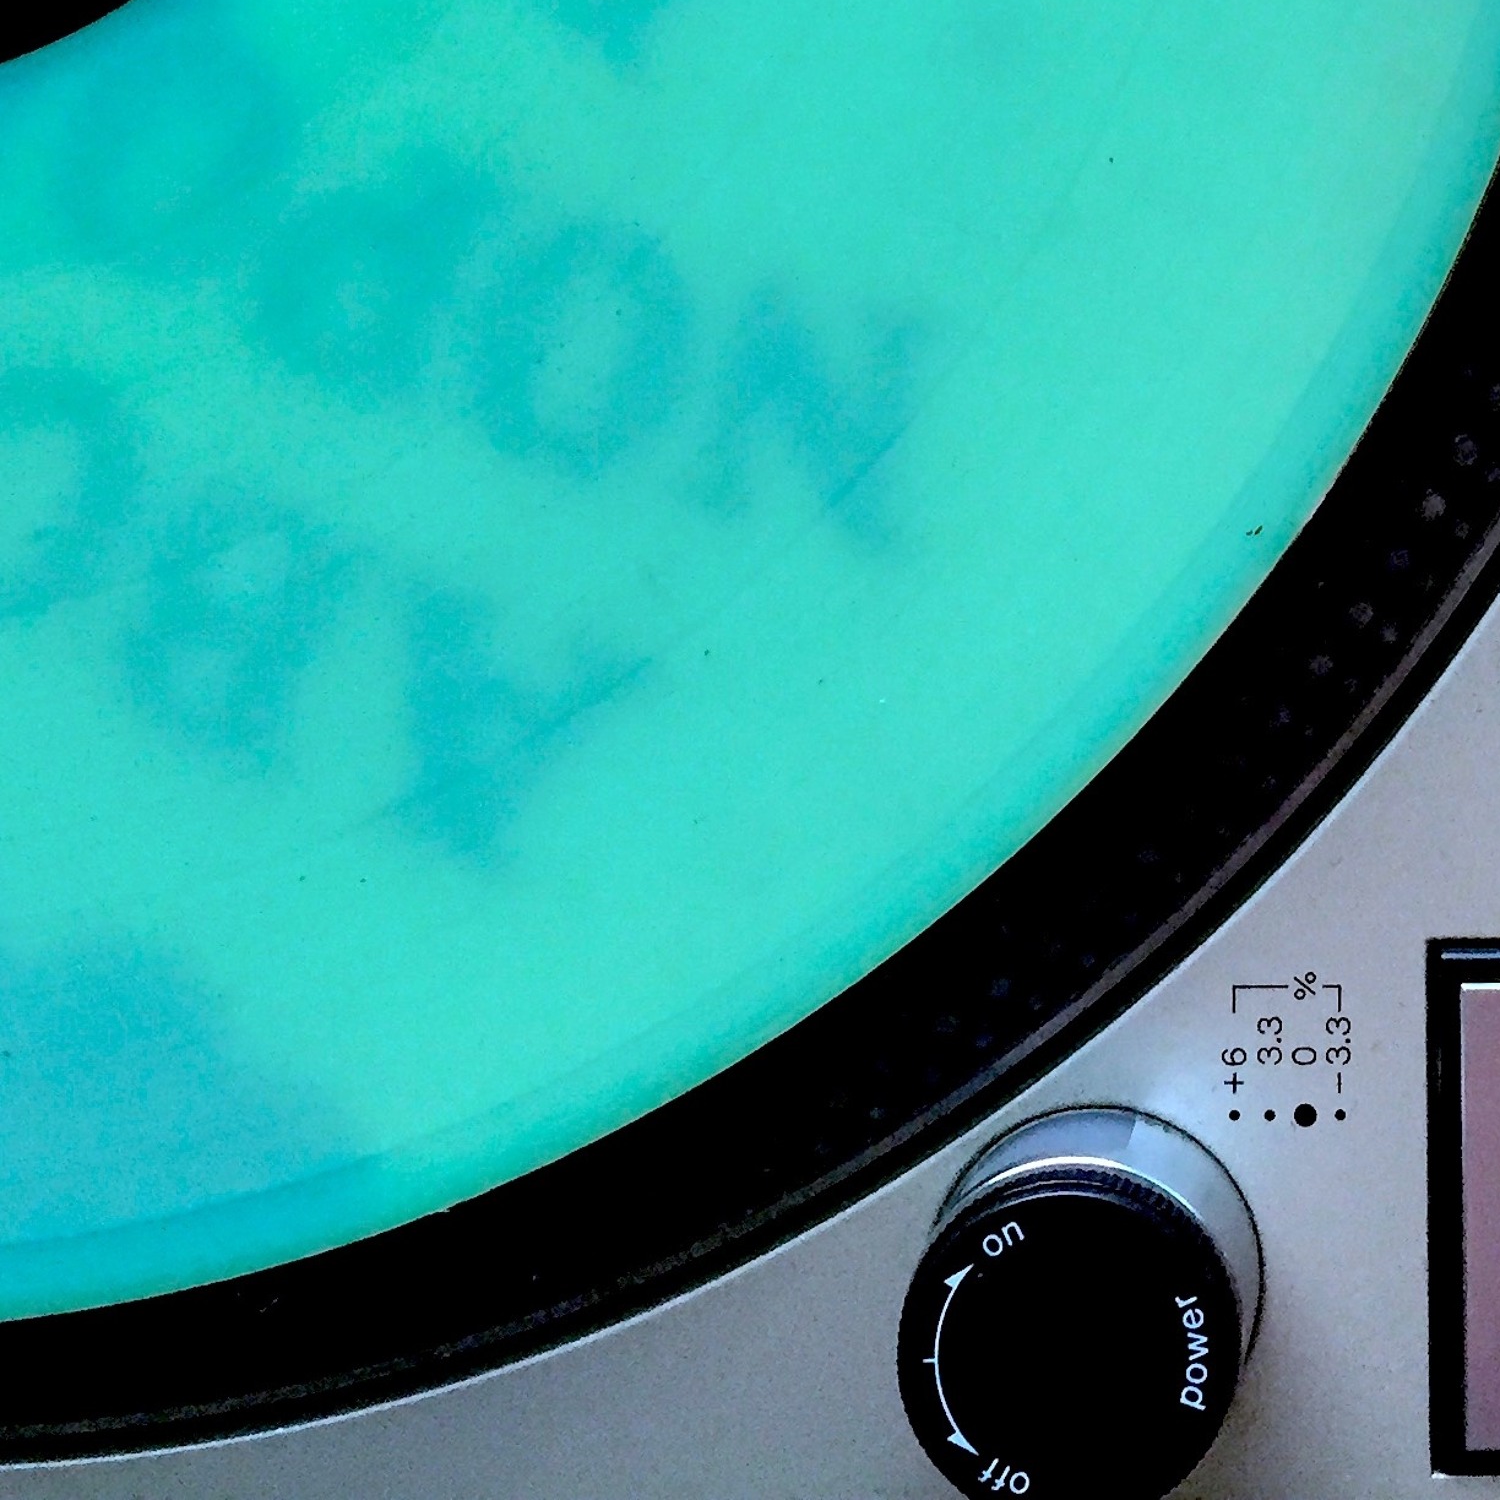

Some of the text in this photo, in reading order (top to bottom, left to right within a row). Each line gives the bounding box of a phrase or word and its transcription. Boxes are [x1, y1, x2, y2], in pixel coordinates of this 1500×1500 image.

[982, 1221, 1025, 1257] on
[1174, 1295, 1210, 1411] power
[978, 1457, 1031, 1495] off
